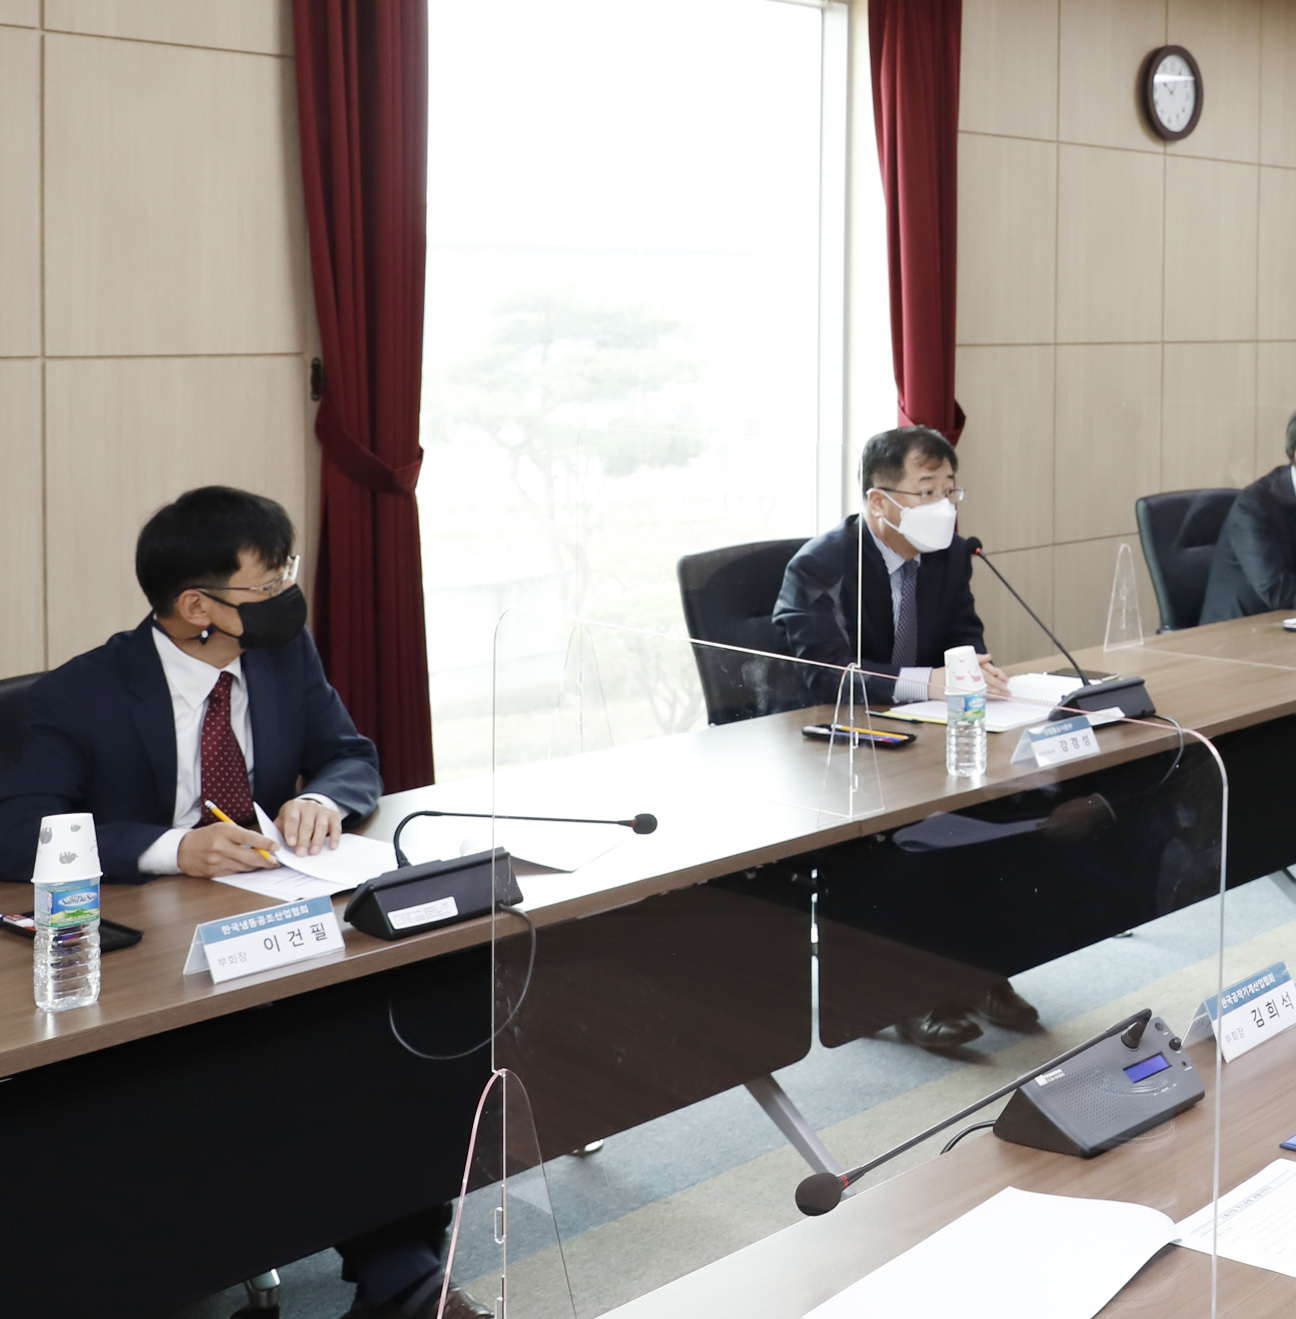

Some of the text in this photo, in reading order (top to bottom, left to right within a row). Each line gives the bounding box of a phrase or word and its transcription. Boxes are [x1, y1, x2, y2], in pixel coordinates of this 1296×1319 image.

[220, 904, 310, 936] 한국냉동공조산업협회
[217, 951, 248, 968] 부회장
[1224, 1026, 1246, 1046] 부회장
